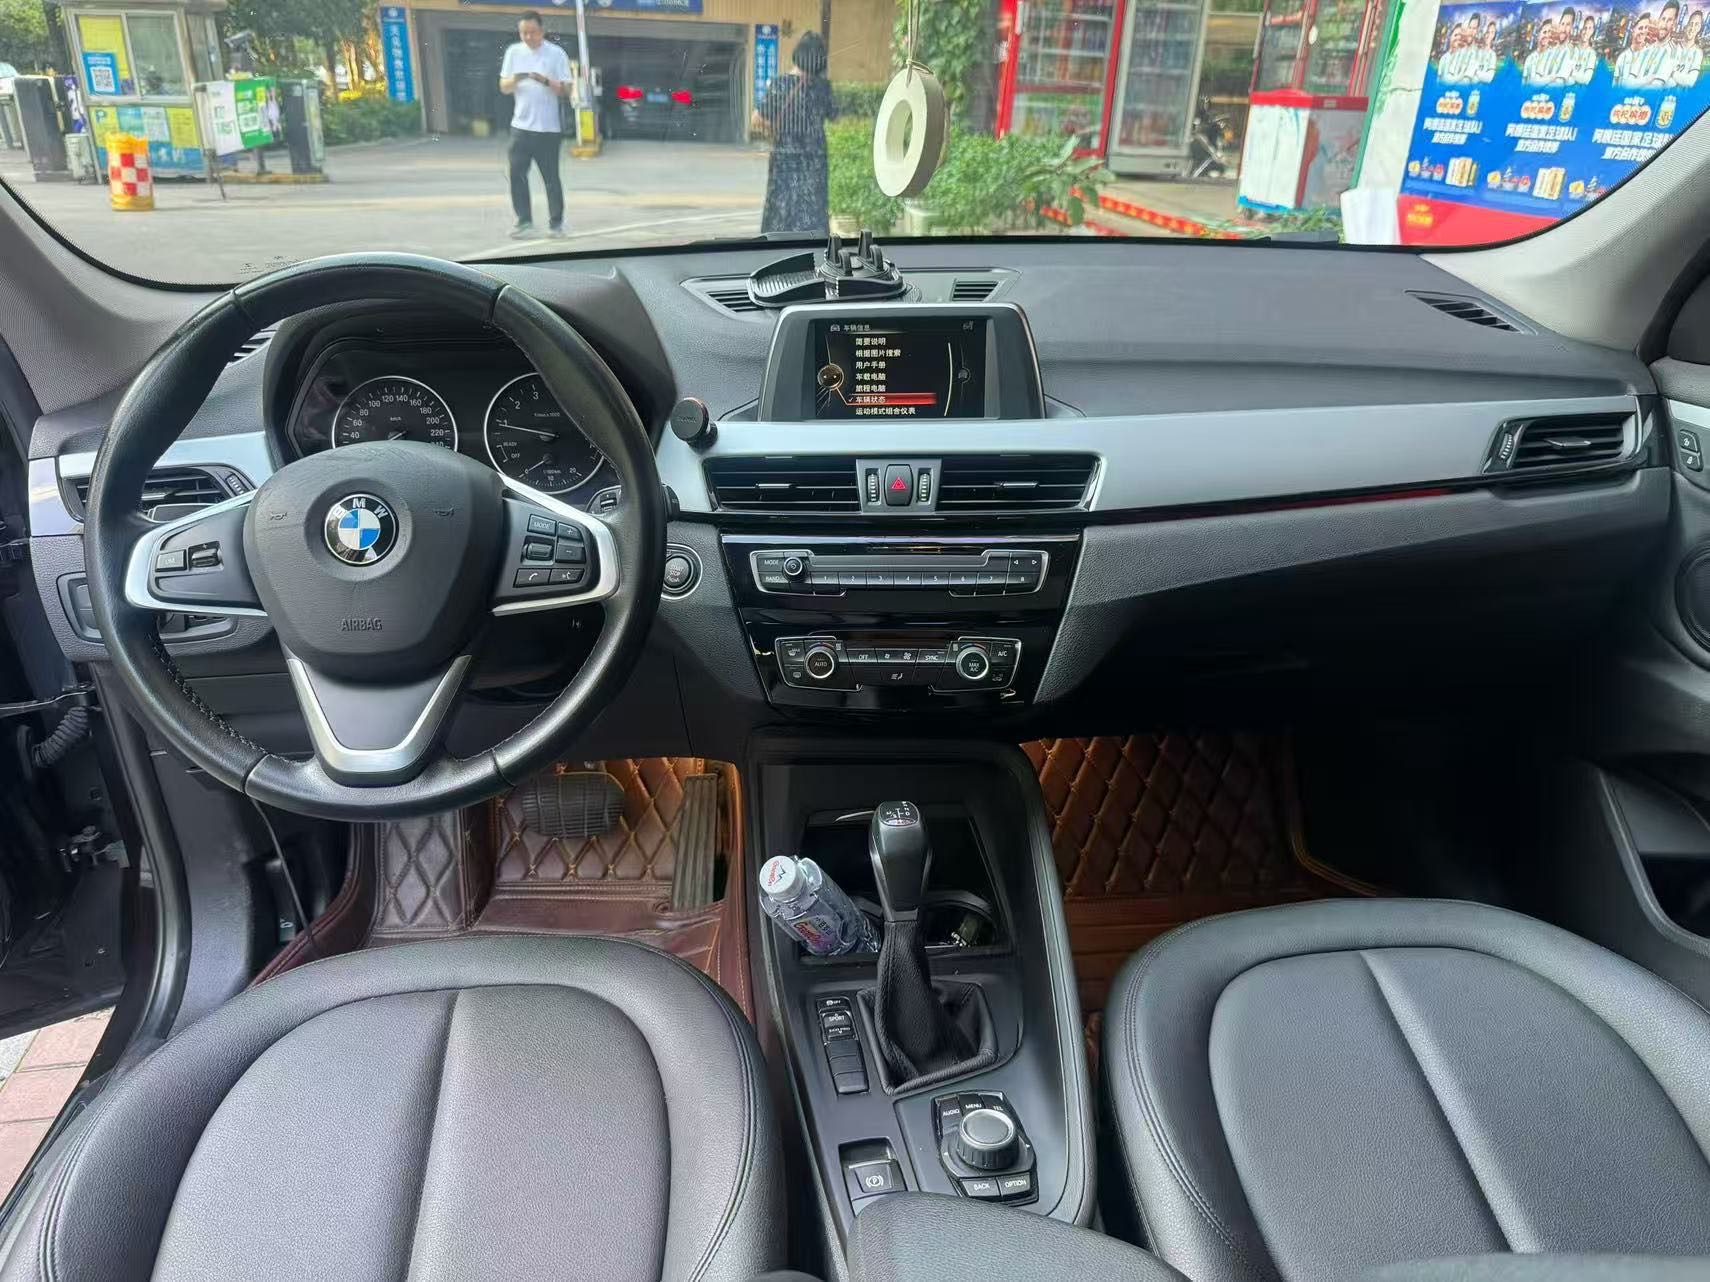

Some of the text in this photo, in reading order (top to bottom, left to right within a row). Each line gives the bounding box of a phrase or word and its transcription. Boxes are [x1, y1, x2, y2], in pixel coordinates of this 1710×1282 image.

[843, 324, 871, 332] 车辆信息
[855, 337, 886, 346] 简要说明
[855, 349, 901, 358] 根据图片搜索
[855, 361, 886, 369] 用户手册
[855, 373, 886, 381] 车载电脑
[855, 384, 886, 392] 旅程电脑
[396, 394, 408, 402] 140
[532, 391, 539, 400] 3
[409, 399, 422, 407] 160
[855, 396, 886, 404] 车辆状态
[514, 401, 521, 410] 2
[855, 407, 916, 415] 运动模式组合仪表
[426, 417, 440, 425] 200
[350, 431, 360, 439] 40
[332, 497, 389, 520] BMW
[341, 618, 383, 631] AIRBAG
[942, 1108, 960, 1117] AUDIO
[973, 1182, 991, 1190] BACK
[1004, 1180, 1027, 1189] OPTION
